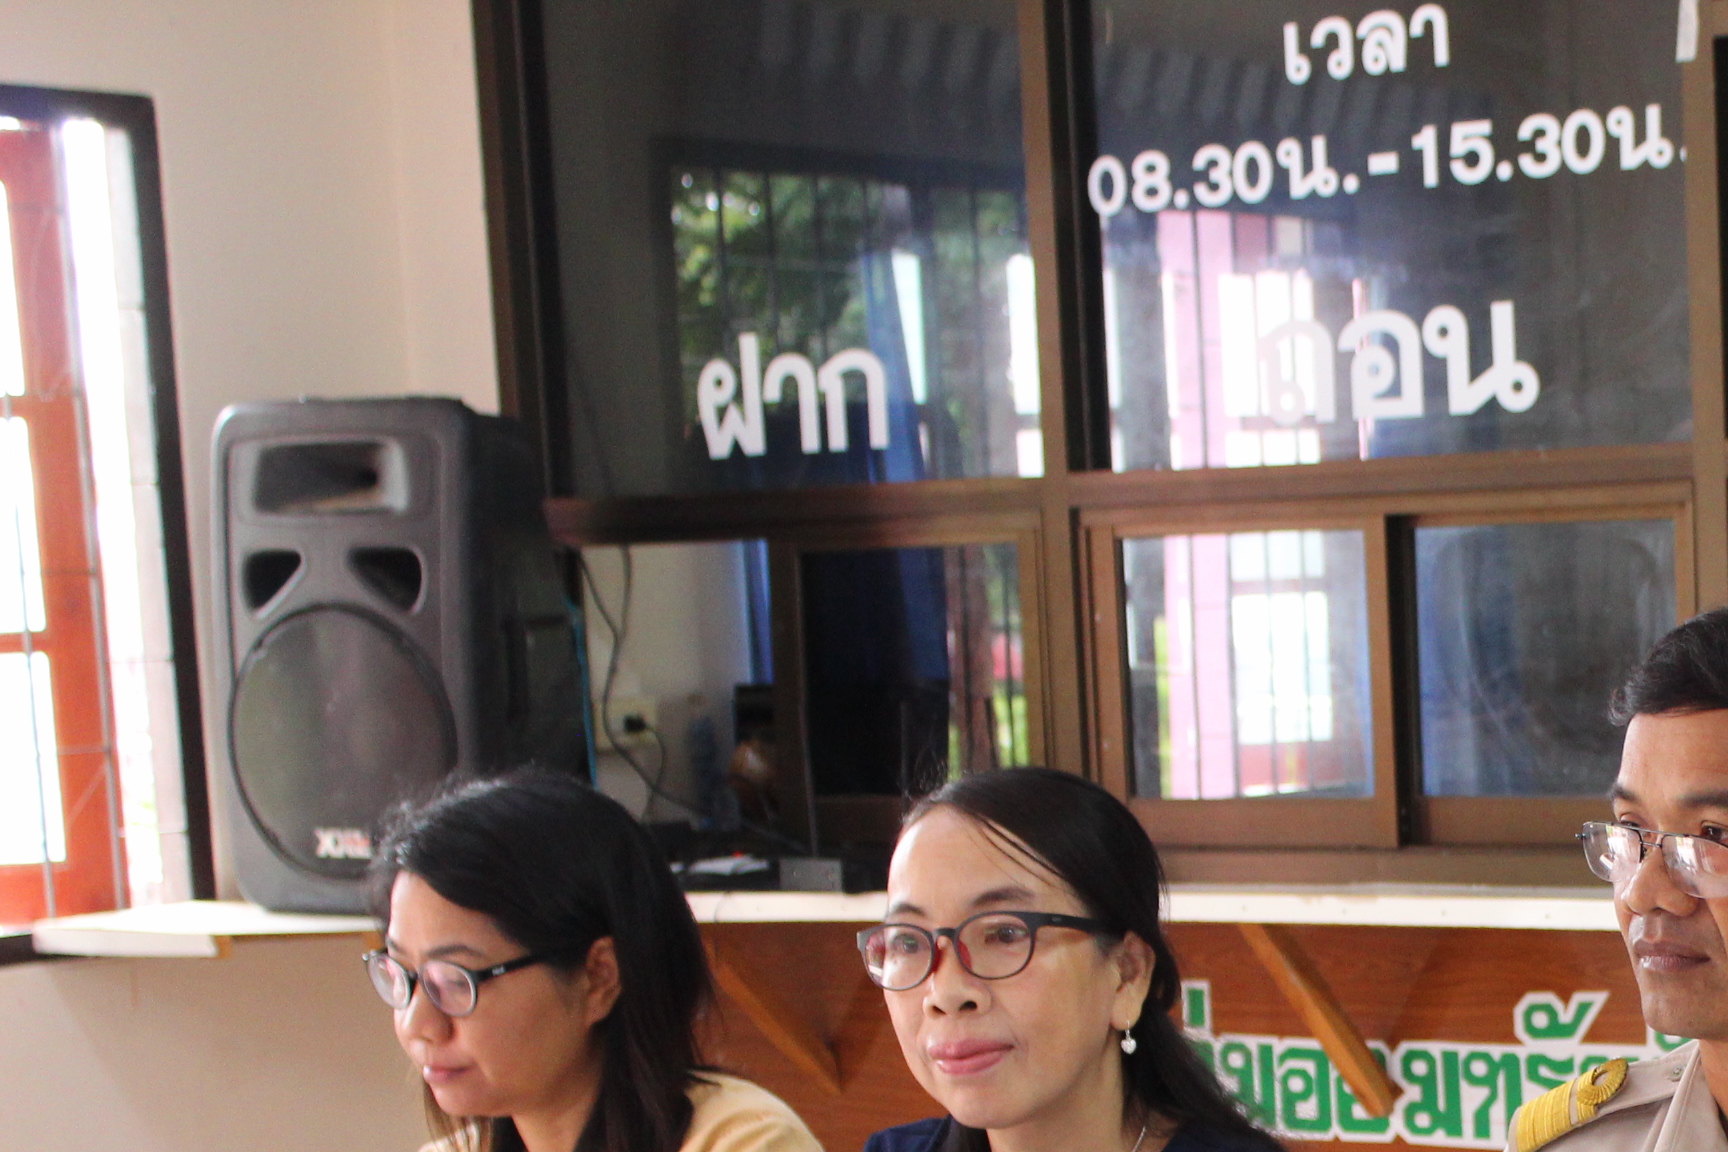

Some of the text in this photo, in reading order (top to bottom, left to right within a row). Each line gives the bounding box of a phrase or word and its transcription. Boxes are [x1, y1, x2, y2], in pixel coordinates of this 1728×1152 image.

[1283, 2, 1451, 85] เวลา
[696, 332, 890, 461] ฝาก
[1260, 300, 1540, 426] ถอน
